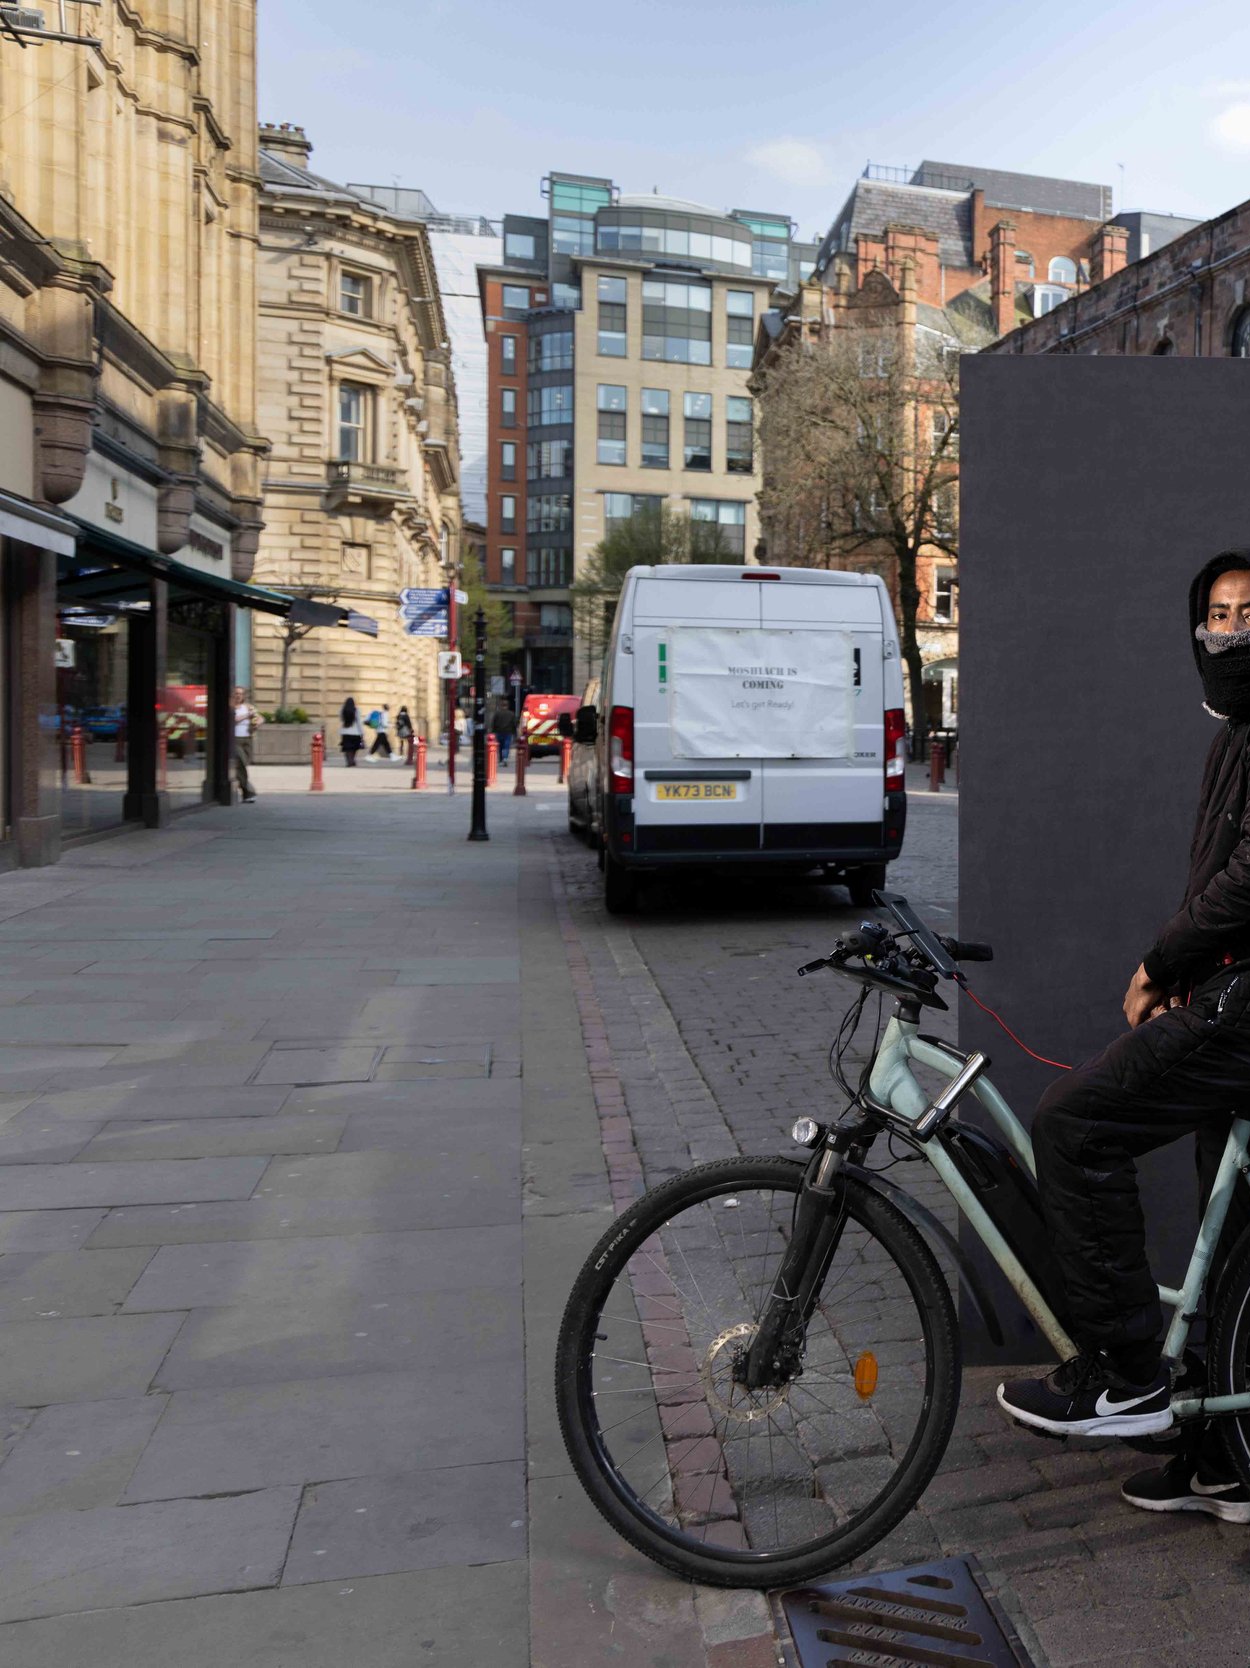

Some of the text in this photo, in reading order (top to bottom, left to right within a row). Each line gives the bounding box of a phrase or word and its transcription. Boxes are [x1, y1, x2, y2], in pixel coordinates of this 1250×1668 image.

[728, 667, 798, 676] MOSHIACH IS
[742, 680, 784, 690] COMING
[663, 785, 731, 797] YK73 BCN
[595, 1228, 629, 1270] CST PIKA
[832, 1594, 969, 1630] MANCHESTER
[848, 1622, 904, 1641] CITY
